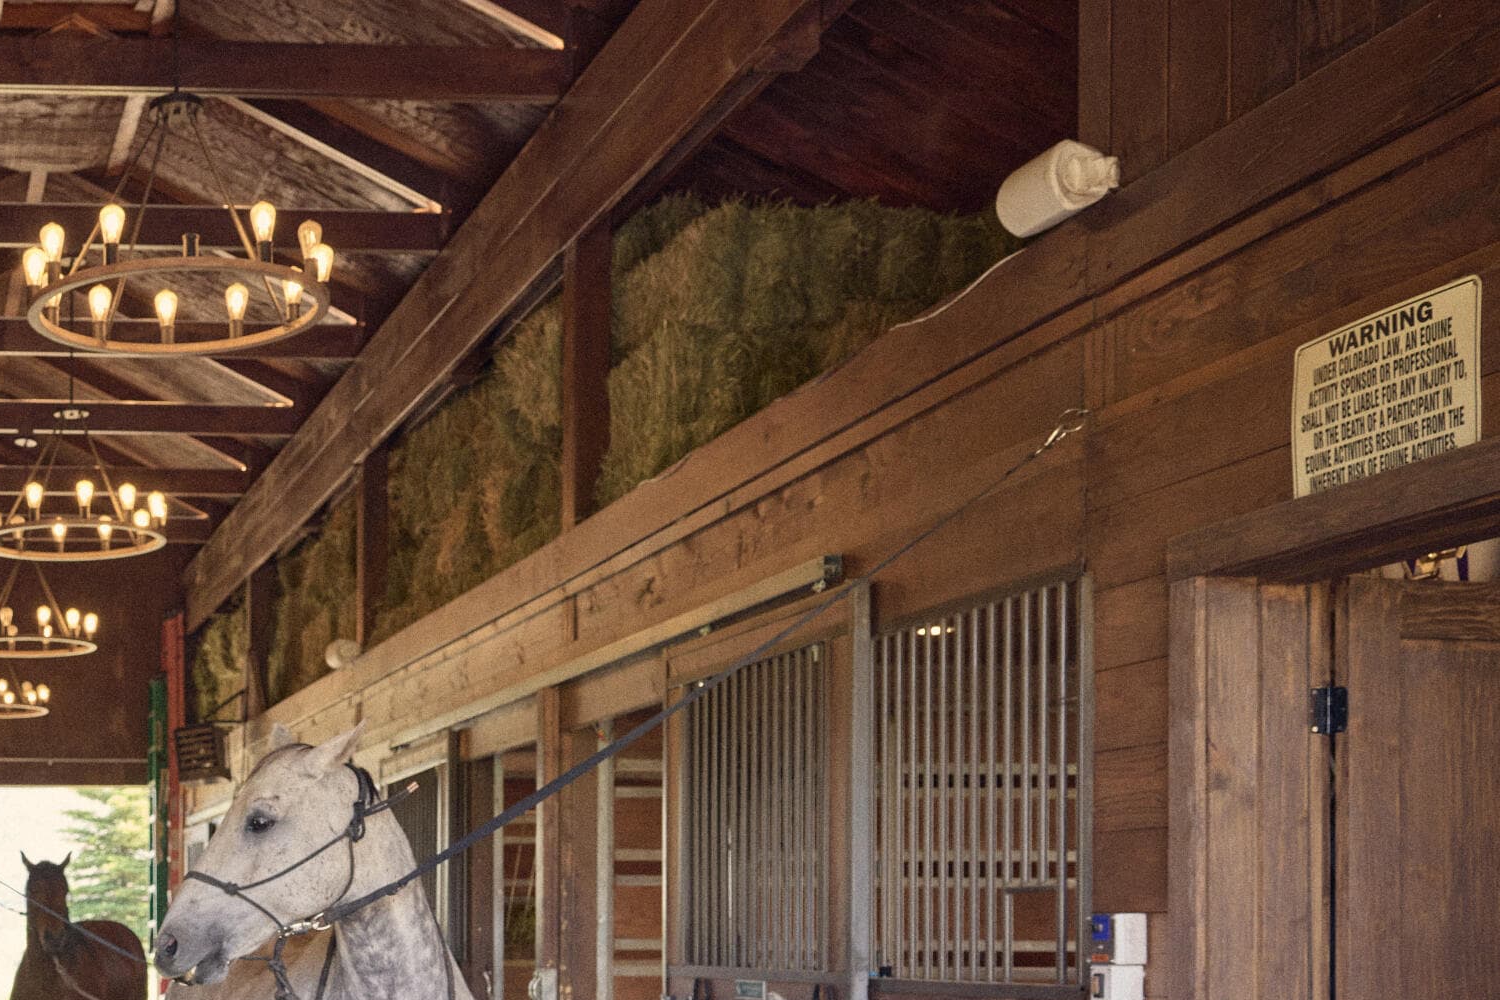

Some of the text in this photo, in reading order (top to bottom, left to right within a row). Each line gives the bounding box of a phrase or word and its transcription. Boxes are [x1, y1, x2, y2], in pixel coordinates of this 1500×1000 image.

[1313, 361, 1337, 386] UNDER
[1339, 344, 1379, 376] COLORADO
[1405, 329, 1417, 352] AN
[1420, 317, 1453, 346] EQUINE
[1329, 301, 1433, 357] WARNING
[1301, 410, 1323, 433] SHALL
[1325, 403, 1339, 424] NOT
[1341, 399, 1351, 418] BE
[1353, 389, 1379, 415] LIABLE
[1381, 383, 1397, 405] FOR
[1400, 376, 1416, 399] ANY
[1419, 362, 1451, 392] INJURY
[1308, 339, 1458, 409] ACTIVITY SPONSOR OR PROFESSIONAL
[1305, 406, 1465, 475] EQUINE ACTIVITIES RESULTING FROM THE
[1313, 386, 1452, 450] OR THE DEATH OF A PARTICIPANT IN
[1348, 460, 1366, 481] RISK
[1367, 457, 1378, 475] OF
[1379, 447, 1409, 472] EQUINE
